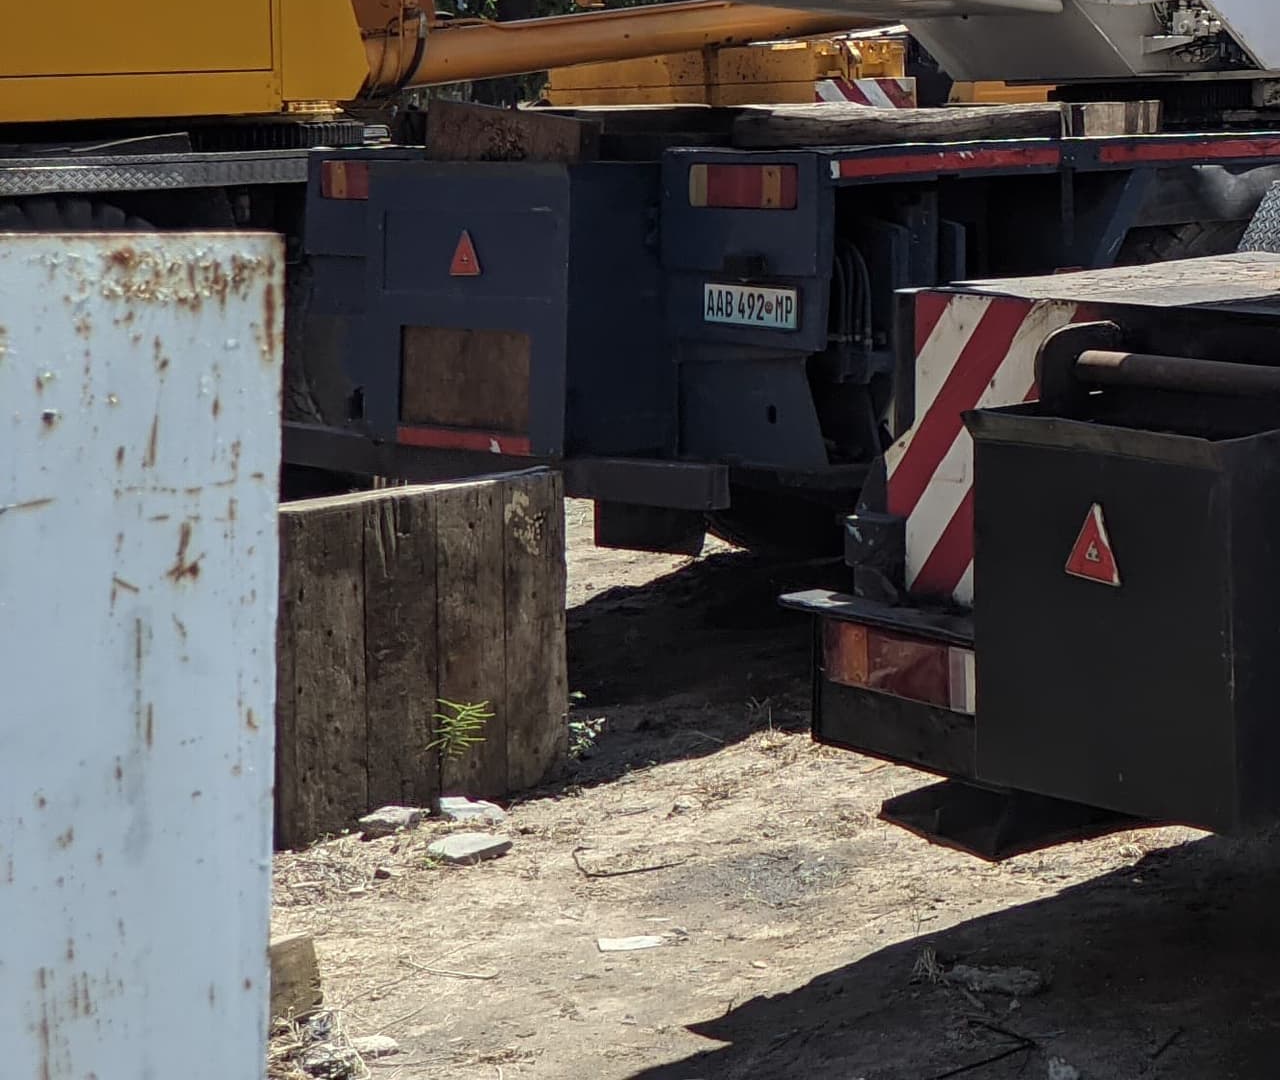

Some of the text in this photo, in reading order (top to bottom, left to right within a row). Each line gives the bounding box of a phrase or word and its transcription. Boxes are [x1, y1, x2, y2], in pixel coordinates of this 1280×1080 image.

[706, 289, 793, 324] AAB 492 MP
